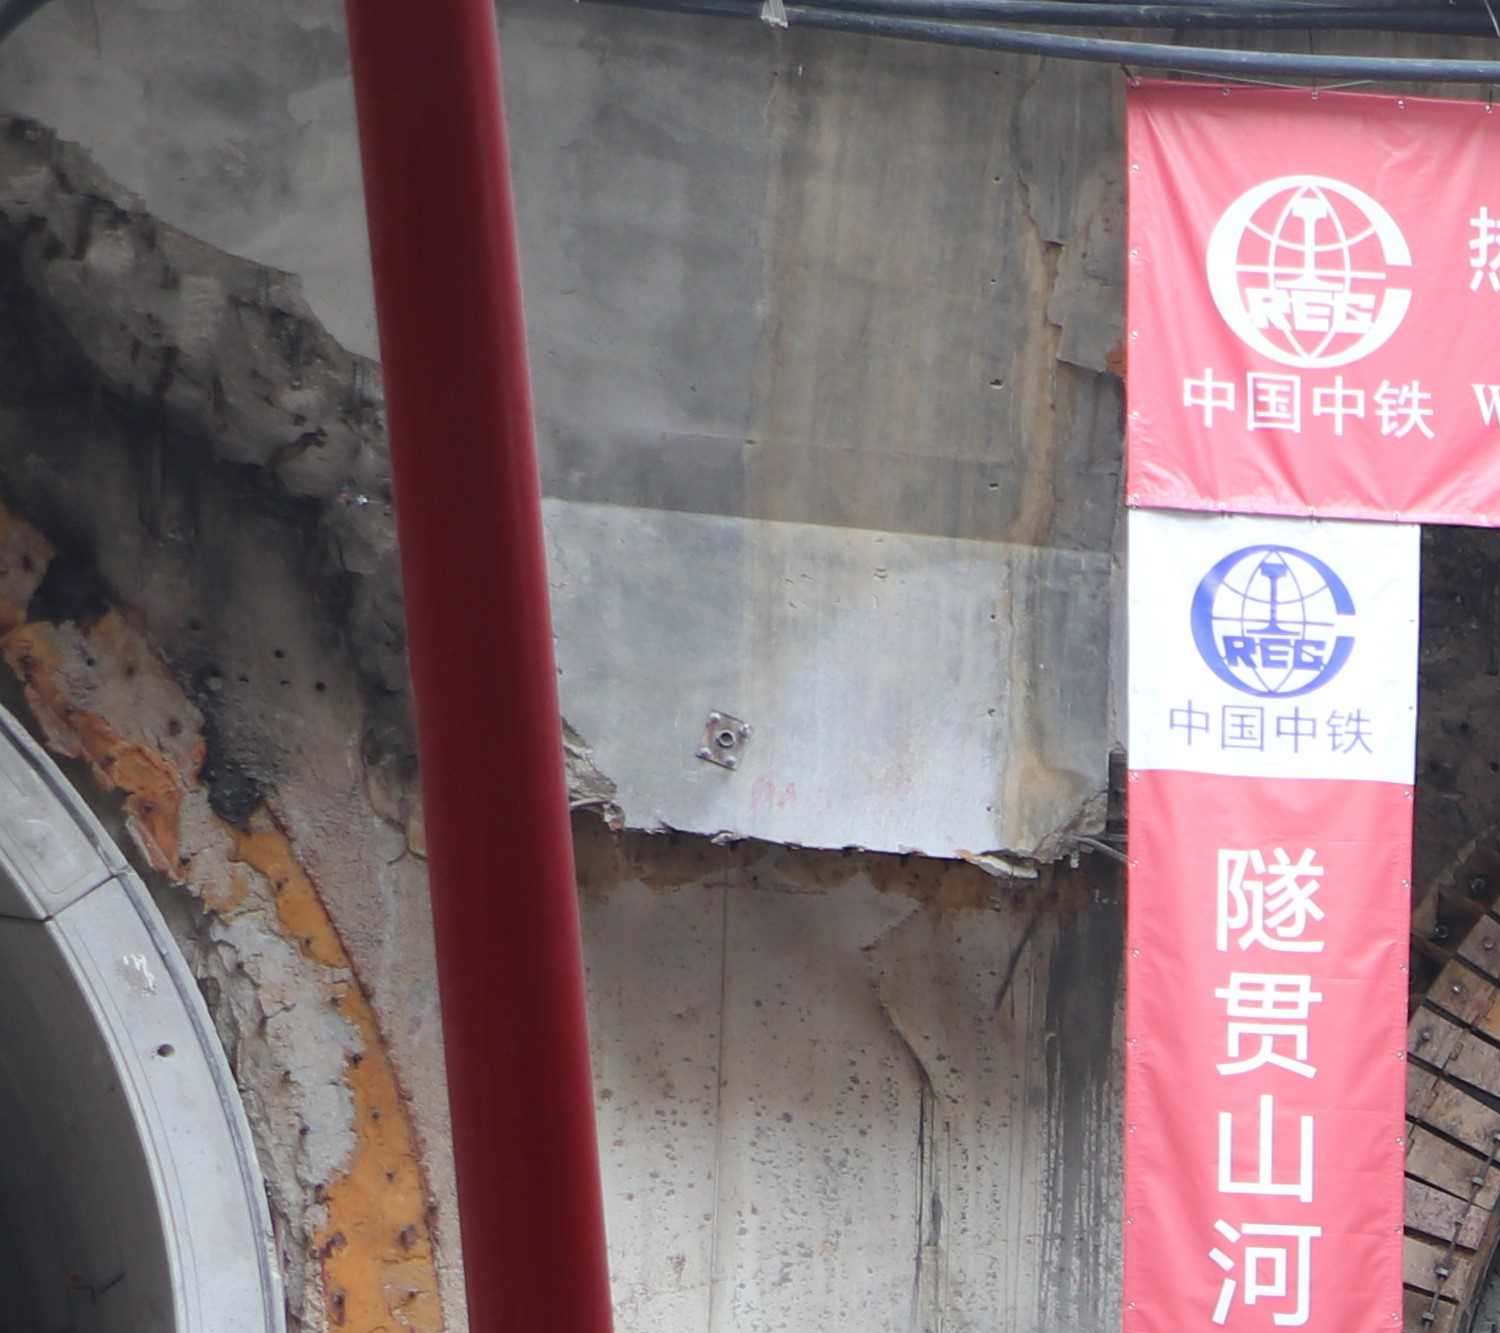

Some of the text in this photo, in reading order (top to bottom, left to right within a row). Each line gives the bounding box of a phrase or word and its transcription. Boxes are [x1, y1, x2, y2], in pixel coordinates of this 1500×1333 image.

[1182, 366, 1435, 442] 中国中铁
[1168, 699, 1374, 755] 中国中铁
[1210, 847, 1326, 1327] 隧贯山河
